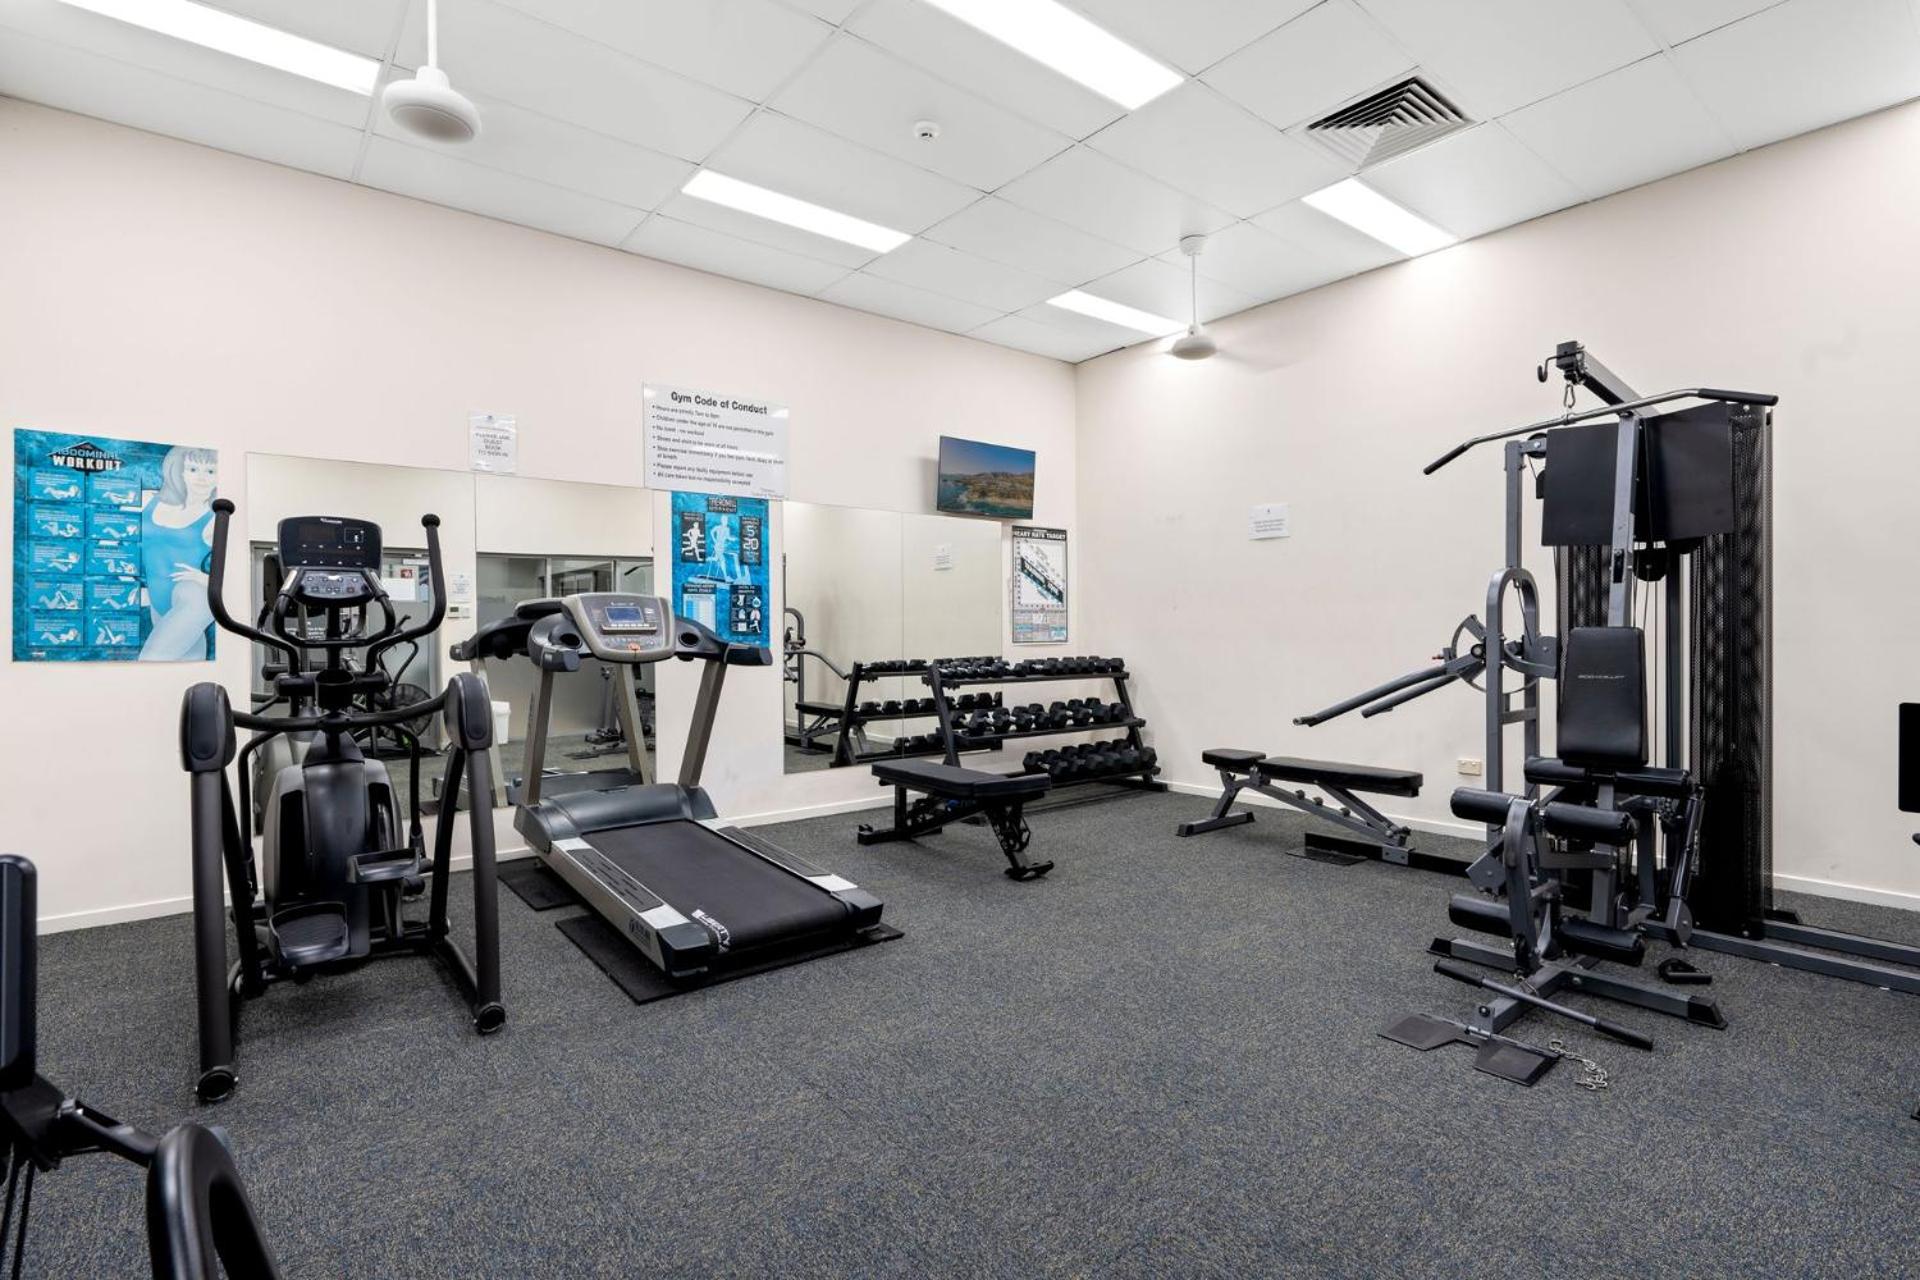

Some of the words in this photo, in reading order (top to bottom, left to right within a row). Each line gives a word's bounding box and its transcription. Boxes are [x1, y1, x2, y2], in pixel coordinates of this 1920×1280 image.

[671, 391, 692, 404] Gym
[694, 394, 718, 407] Code
[720, 400, 729, 409] of
[731, 400, 768, 414] Conduct
[52, 454, 122, 472] WORKOUT
